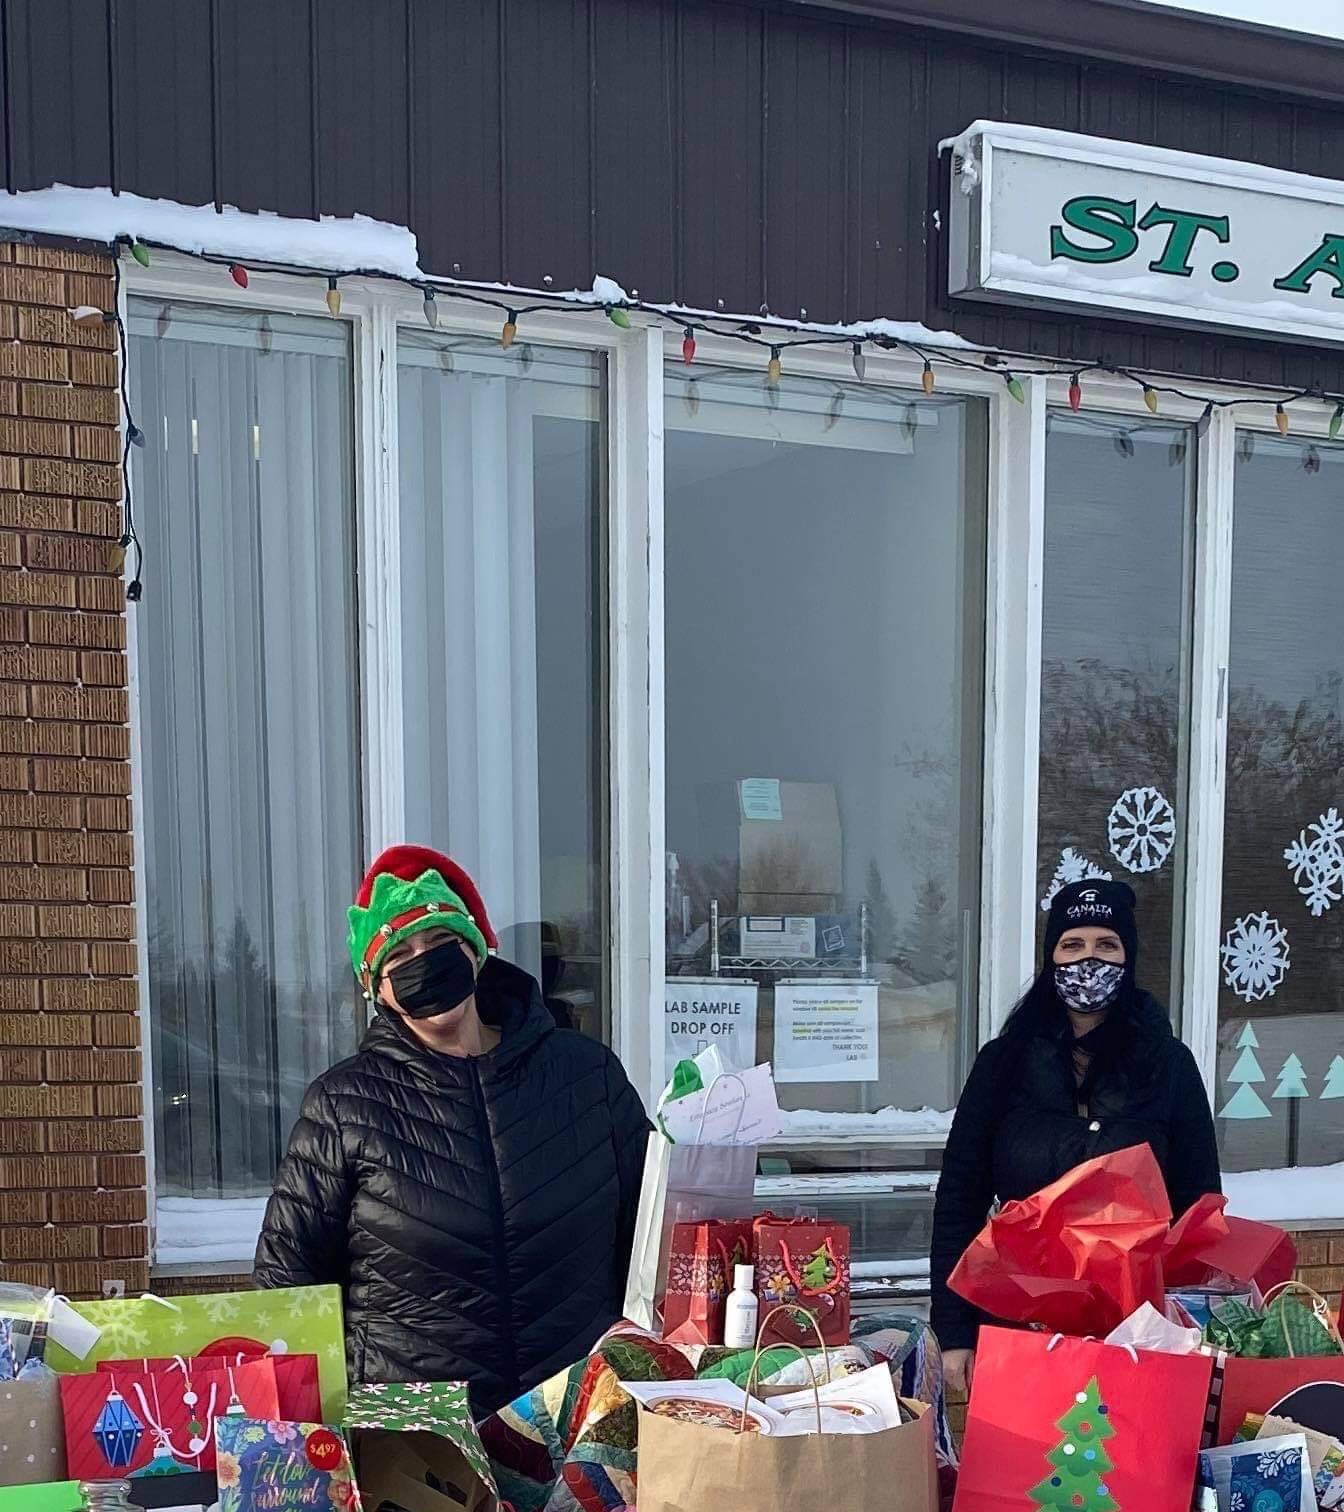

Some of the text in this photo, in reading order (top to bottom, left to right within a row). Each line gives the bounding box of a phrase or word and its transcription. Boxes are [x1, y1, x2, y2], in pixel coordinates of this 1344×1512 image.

[1049, 195, 1240, 283] ST.
[1067, 903, 1112, 915] CANALTA
[664, 1001, 741, 1014] LAB SAMPLE
[671, 1022, 735, 1035] DROP OFF
